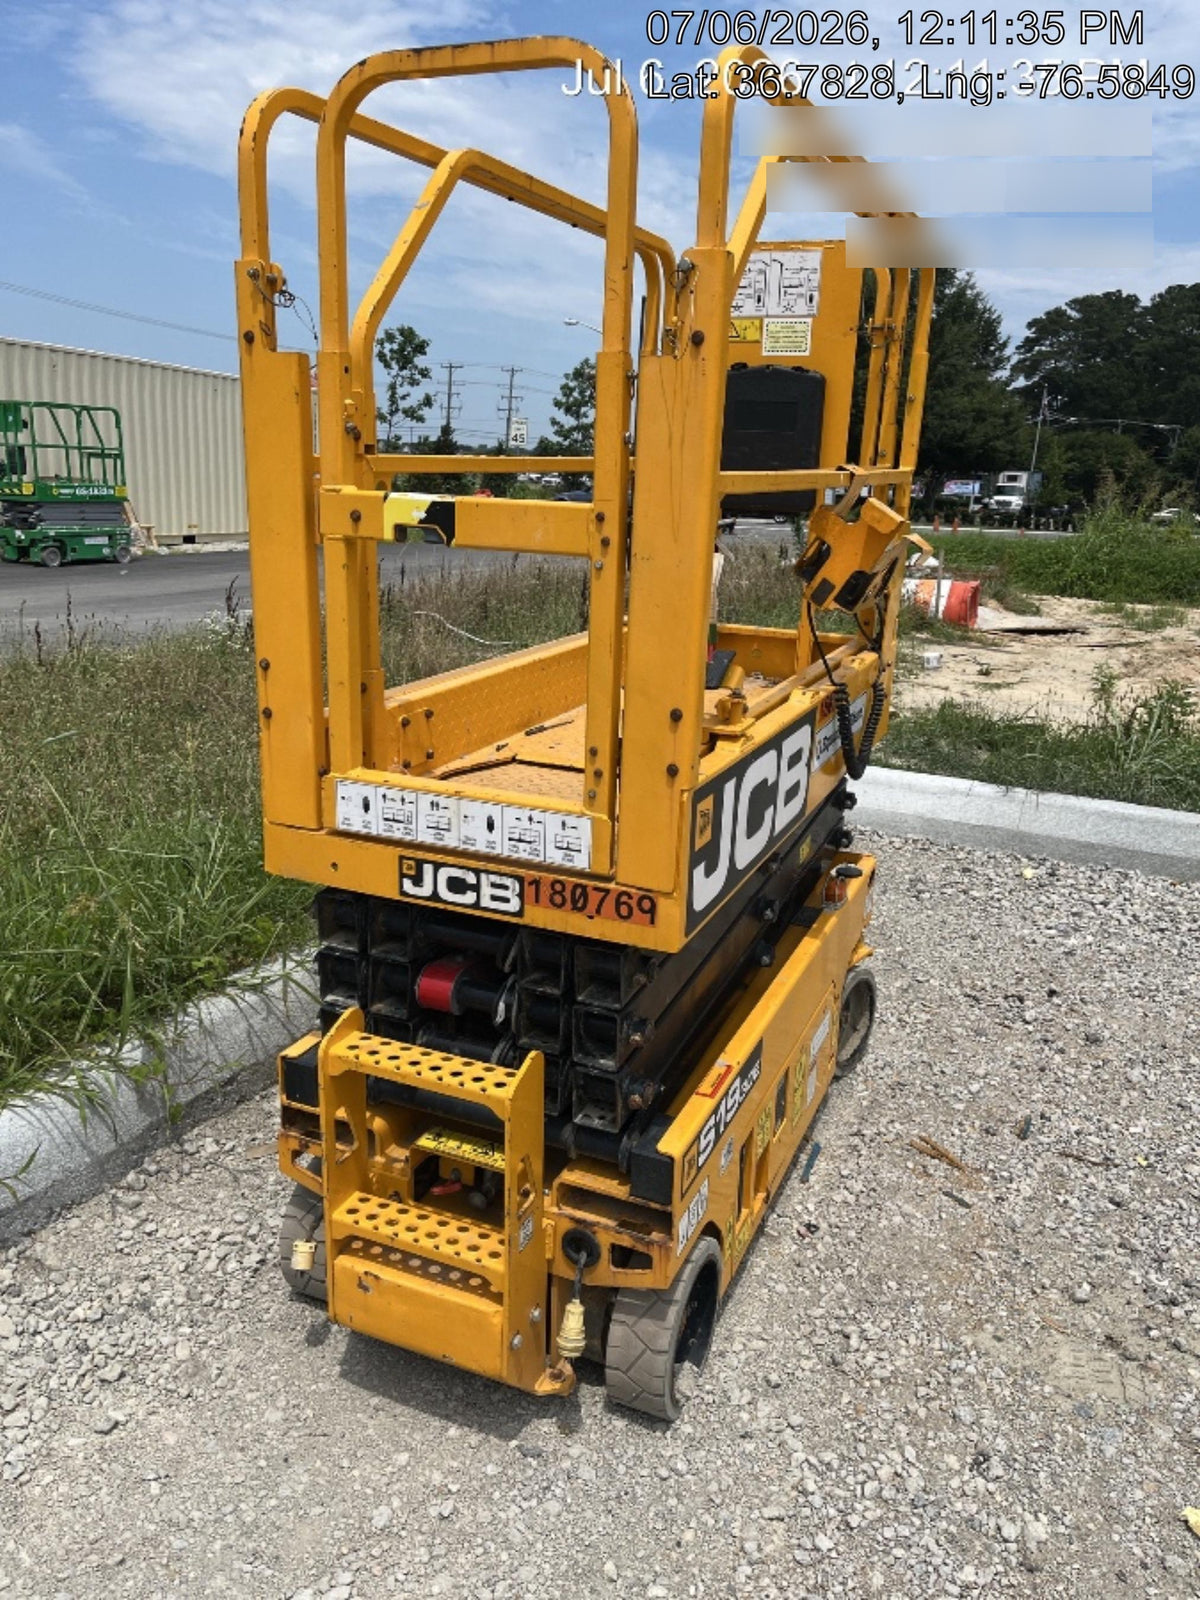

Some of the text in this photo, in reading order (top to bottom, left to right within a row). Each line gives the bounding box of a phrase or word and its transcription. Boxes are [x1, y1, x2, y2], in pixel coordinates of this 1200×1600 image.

[511, 433, 525, 444] 45
[693, 724, 811, 912] JCB
[402, 863, 521, 913] JCB
[527, 876, 658, 925] 180769
